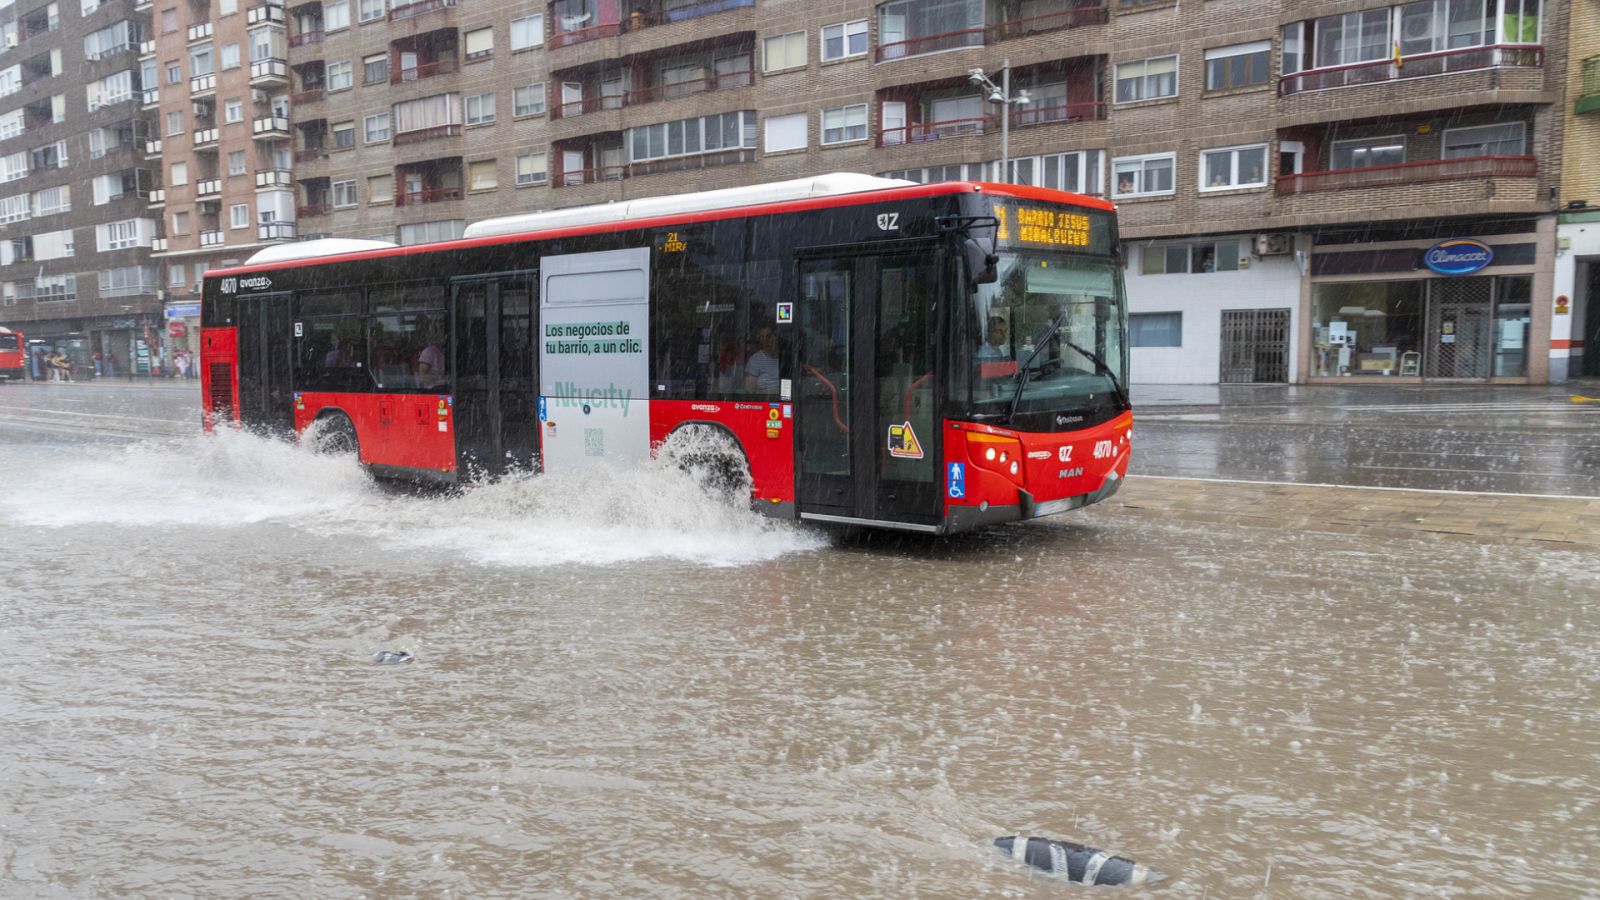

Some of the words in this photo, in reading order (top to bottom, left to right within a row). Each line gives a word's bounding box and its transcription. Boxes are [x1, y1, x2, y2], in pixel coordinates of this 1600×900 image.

[1058, 212, 1089, 231] JESUS
[667, 232, 678, 242] 21
[220, 277, 237, 294] 4870
[240, 276, 266, 288] avanza
[545, 324, 563, 337] Los
[566, 322, 613, 339] negocios
[616, 320, 630, 335] de
[546, 341, 556, 354] tu
[558, 340, 591, 356] barrio,
[594, 343, 600, 353] a
[603, 342, 616, 353] un
[619, 338, 642, 353] clic.
[1093, 440, 1112, 459] 4870
[1058, 467, 1084, 479] MAN
